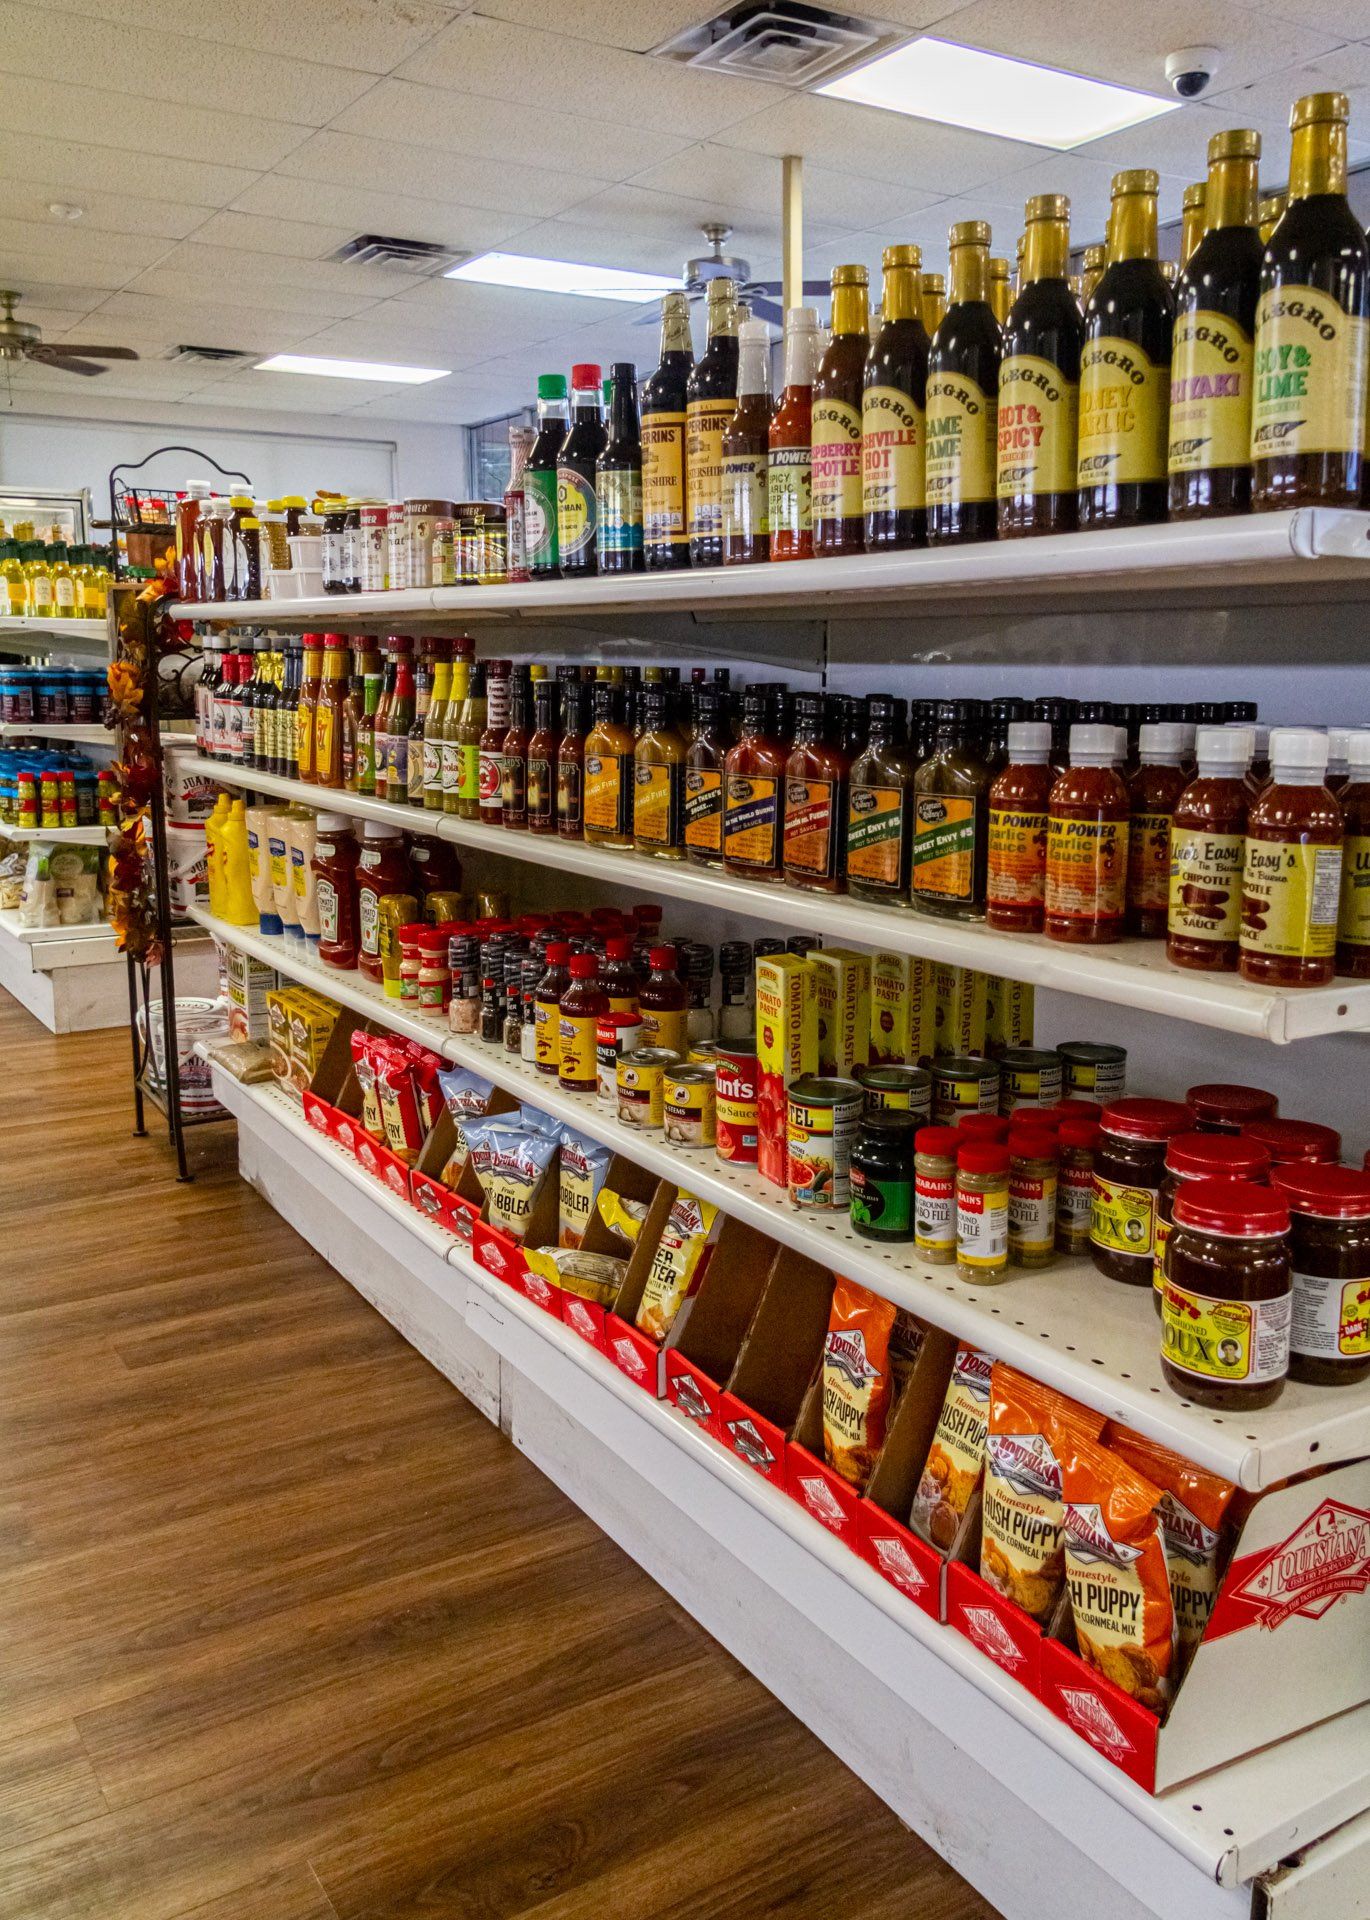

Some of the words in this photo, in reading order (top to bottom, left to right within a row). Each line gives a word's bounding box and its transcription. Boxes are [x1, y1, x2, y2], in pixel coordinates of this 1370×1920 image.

[1293, 345, 1312, 368] &
[1258, 371, 1308, 401] LIME
[999, 405, 1025, 426] HOT
[1027, 405, 1041, 423] &
[865, 449, 892, 470] HOT
[601, 779, 617, 789] FIRE
[651, 789, 667, 800] FIRE
[867, 822, 887, 834] ENVY
[888, 817, 900, 828] #5
[1067, 823, 1117, 838] POWER
[913, 839, 935, 854] SWEET
[936, 832, 958, 846] ENVY
[960, 826, 973, 838] #5
[1051, 837, 1093, 851] garlic
[1251, 848, 1297, 871] Easy's
[1182, 872, 1231, 886] CHIPOTLE
[1182, 917, 1219, 931] SAUCE
[845, 965, 857, 1021] TOMATO
[873, 976, 905, 991] TOMATO
[876, 988, 901, 1001] PASTE
[757, 989, 782, 1008] TOMATO
[760, 1002, 778, 1018] PASTE
[790, 972, 802, 1030] TOMATO
[911, 1016, 921, 1058] PASTE
[961, 1012, 972, 1053] PASTE
[790, 1033, 802, 1076] PASTE
[845, 1024, 855, 1067] PASTE
[668, 1106, 686, 1116] STEMS
[727, 1106, 759, 1119] Sauce
[501, 1212, 511, 1222] MIX
[1020, 1209, 1039, 1222] FILÉ
[962, 1223, 981, 1237] FILÉ
[1344, 1323, 1364, 1336] DARK
[829, 1331, 867, 1374] LOUISIANA
[836, 1392, 865, 1431] PUPPY
[850, 1428, 861, 1442] MIX
[956, 1438, 980, 1463] CORNMEAL
[996, 1435, 1062, 1489] LOUISIANA
[995, 1487, 1046, 1517] Homestyle
[985, 1492, 1013, 1531] HUSH
[1013, 1510, 1064, 1549] PUPPY
[1063, 1504, 1117, 1560] LOUISIANA
[1006, 1533, 1040, 1560] CORNMEAL
[1267, 1521, 1370, 1598] LOUISIANA
[1087, 1583, 1141, 1622] PUPPY
[1081, 1612, 1120, 1634] CORNMEAL
[1121, 1624, 1136, 1637] MIX
